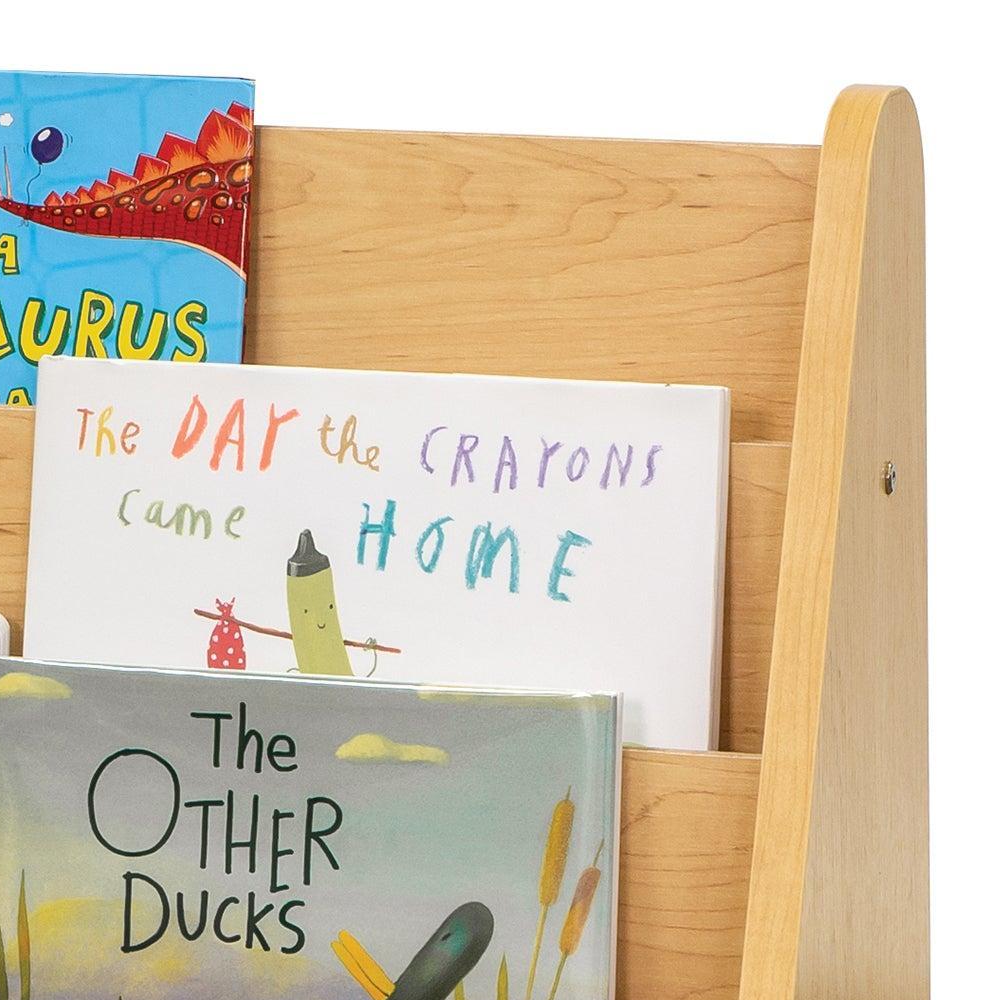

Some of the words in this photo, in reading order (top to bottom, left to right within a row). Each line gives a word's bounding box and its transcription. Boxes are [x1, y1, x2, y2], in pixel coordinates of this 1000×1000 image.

[77, 405, 141, 457] The
[172, 394, 299, 472] DAY
[316, 414, 380, 472] the
[420, 425, 663, 493] CRAYONS
[356, 500, 593, 602] HOME
[190, 702, 298, 773] The
[87, 747, 344, 893] OTHER
